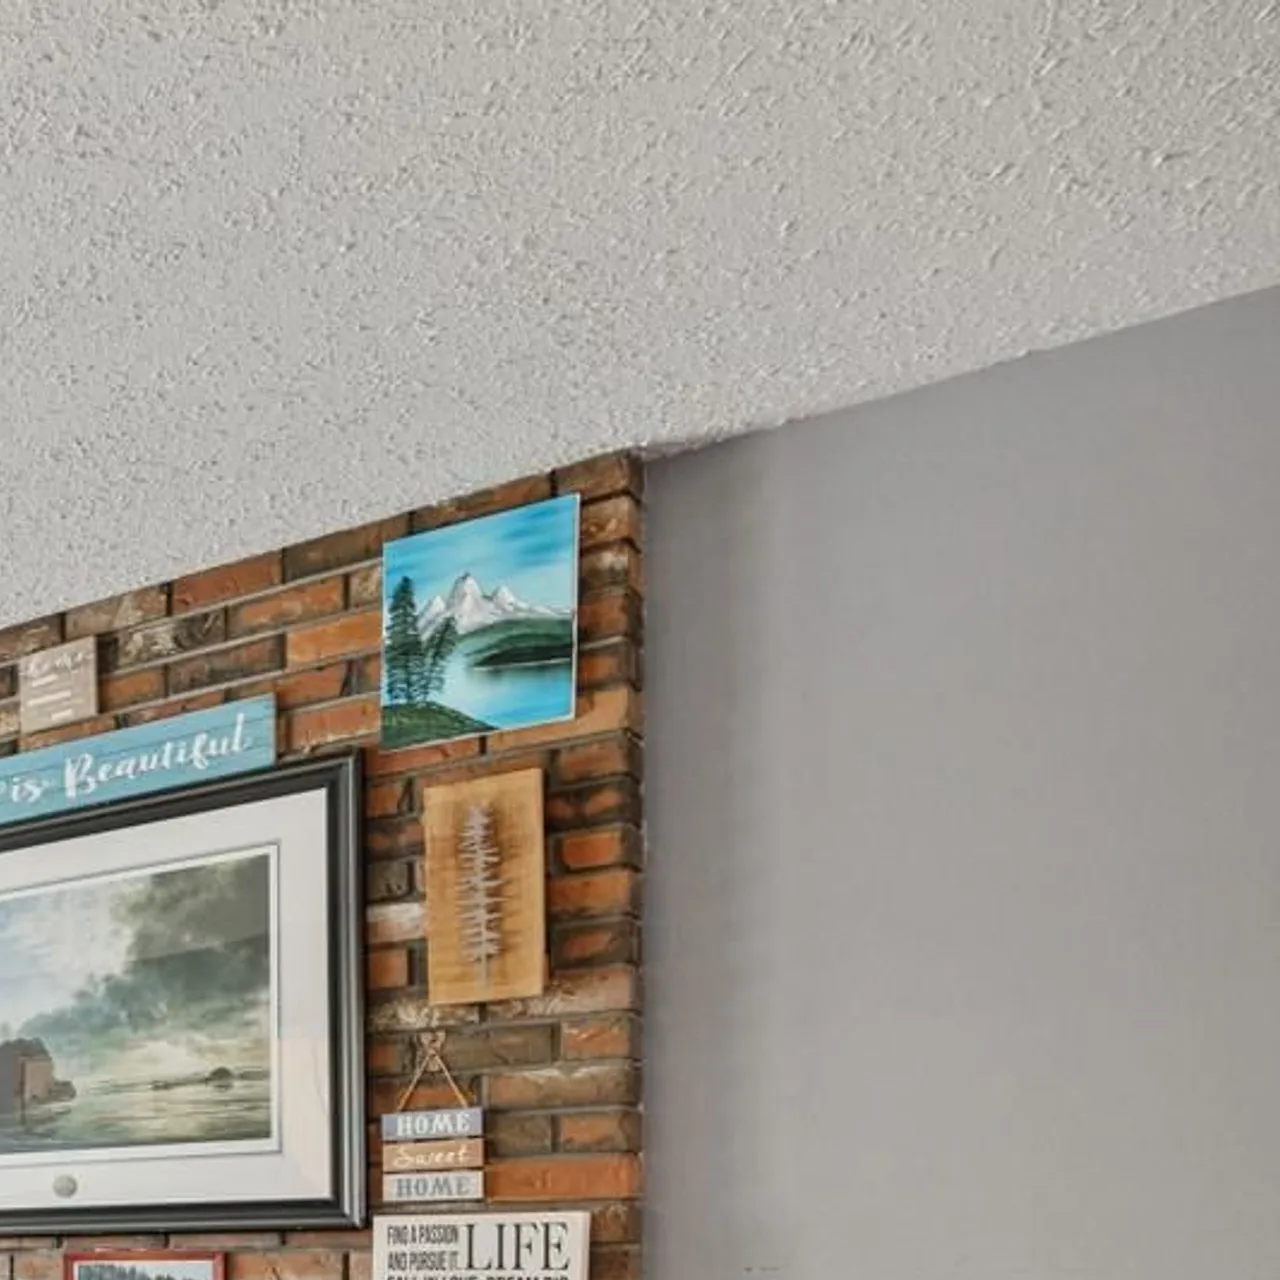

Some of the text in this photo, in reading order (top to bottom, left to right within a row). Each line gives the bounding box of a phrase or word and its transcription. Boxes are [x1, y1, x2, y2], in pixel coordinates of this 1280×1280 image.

[11, 776, 57, 803] is
[63, 712, 251, 799] Beautiful
[396, 1111, 472, 1137] HOME
[396, 1174, 472, 1198] HOME
[419, 1224, 459, 1244] PASSION
[460, 1221, 571, 1271] LIFE
[388, 1251, 407, 1271] AND
[409, 1250, 446, 1271] PURSUE
